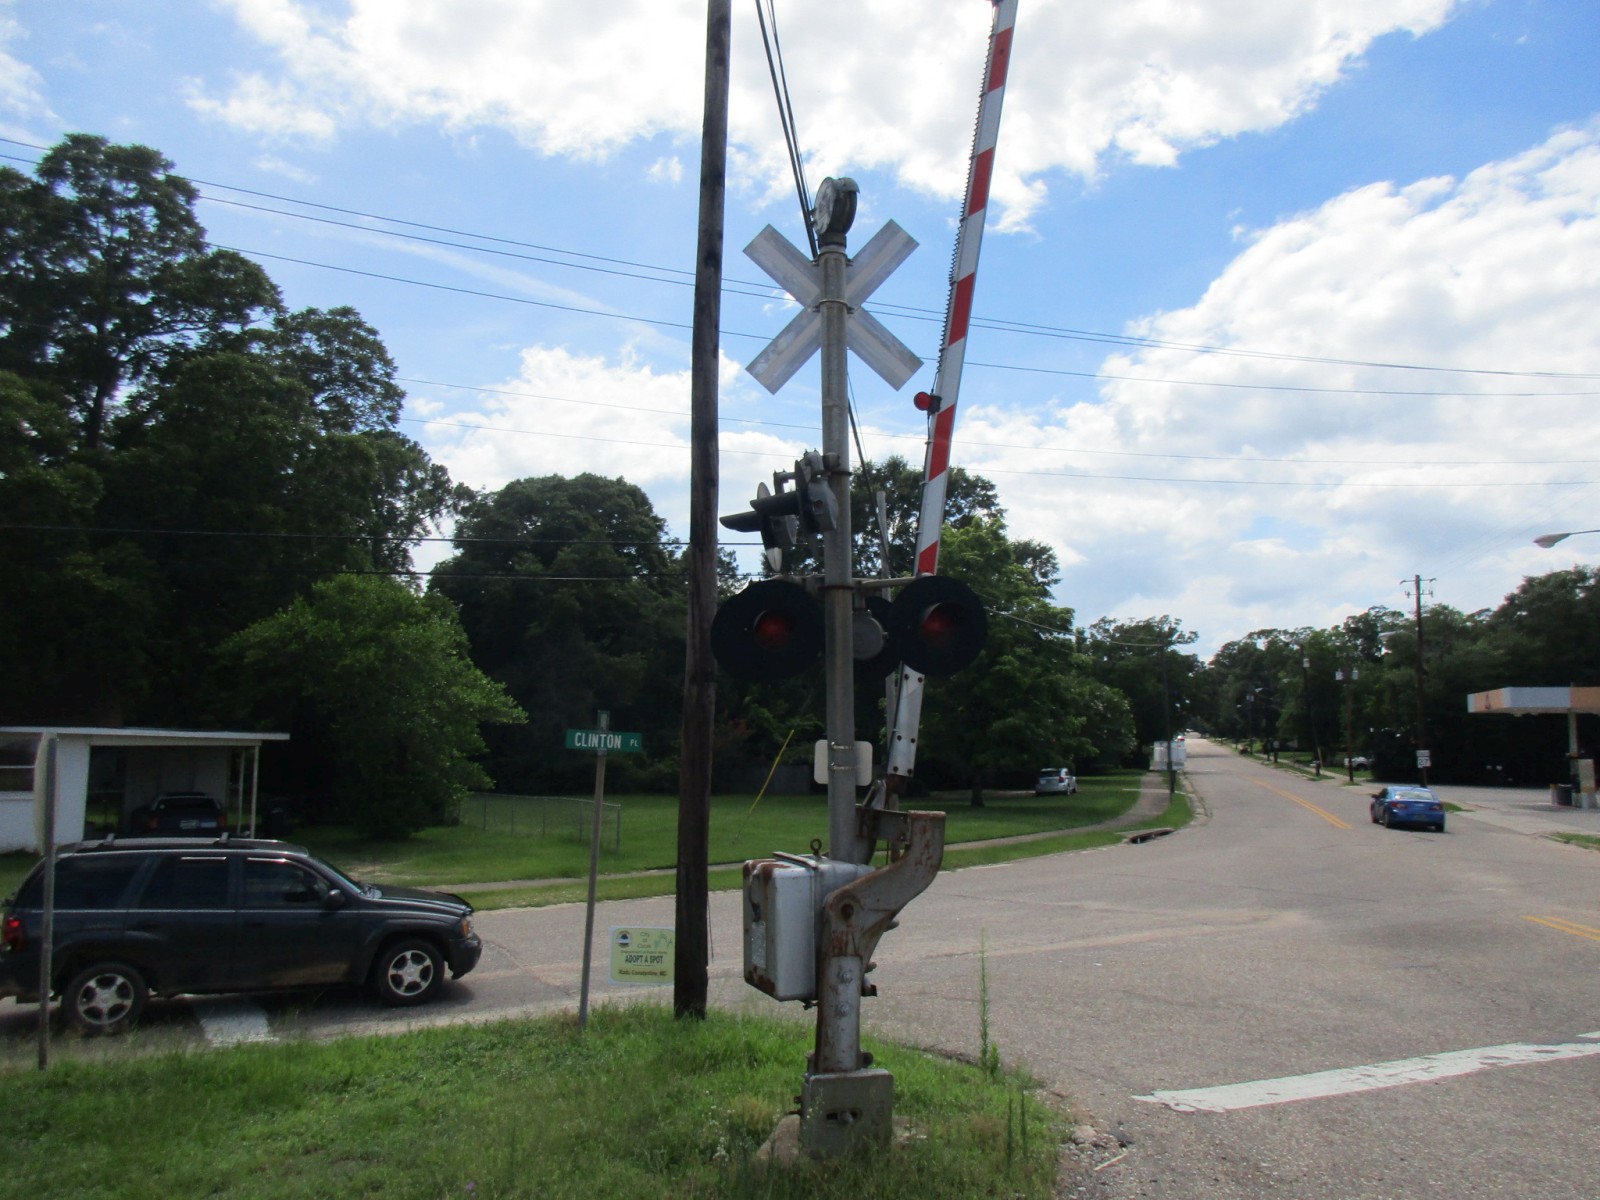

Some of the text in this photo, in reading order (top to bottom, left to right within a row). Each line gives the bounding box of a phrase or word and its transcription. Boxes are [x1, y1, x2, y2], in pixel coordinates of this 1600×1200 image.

[574, 732, 622, 749] CLINTON
[625, 954, 664, 965] ADOPT A SPOT
